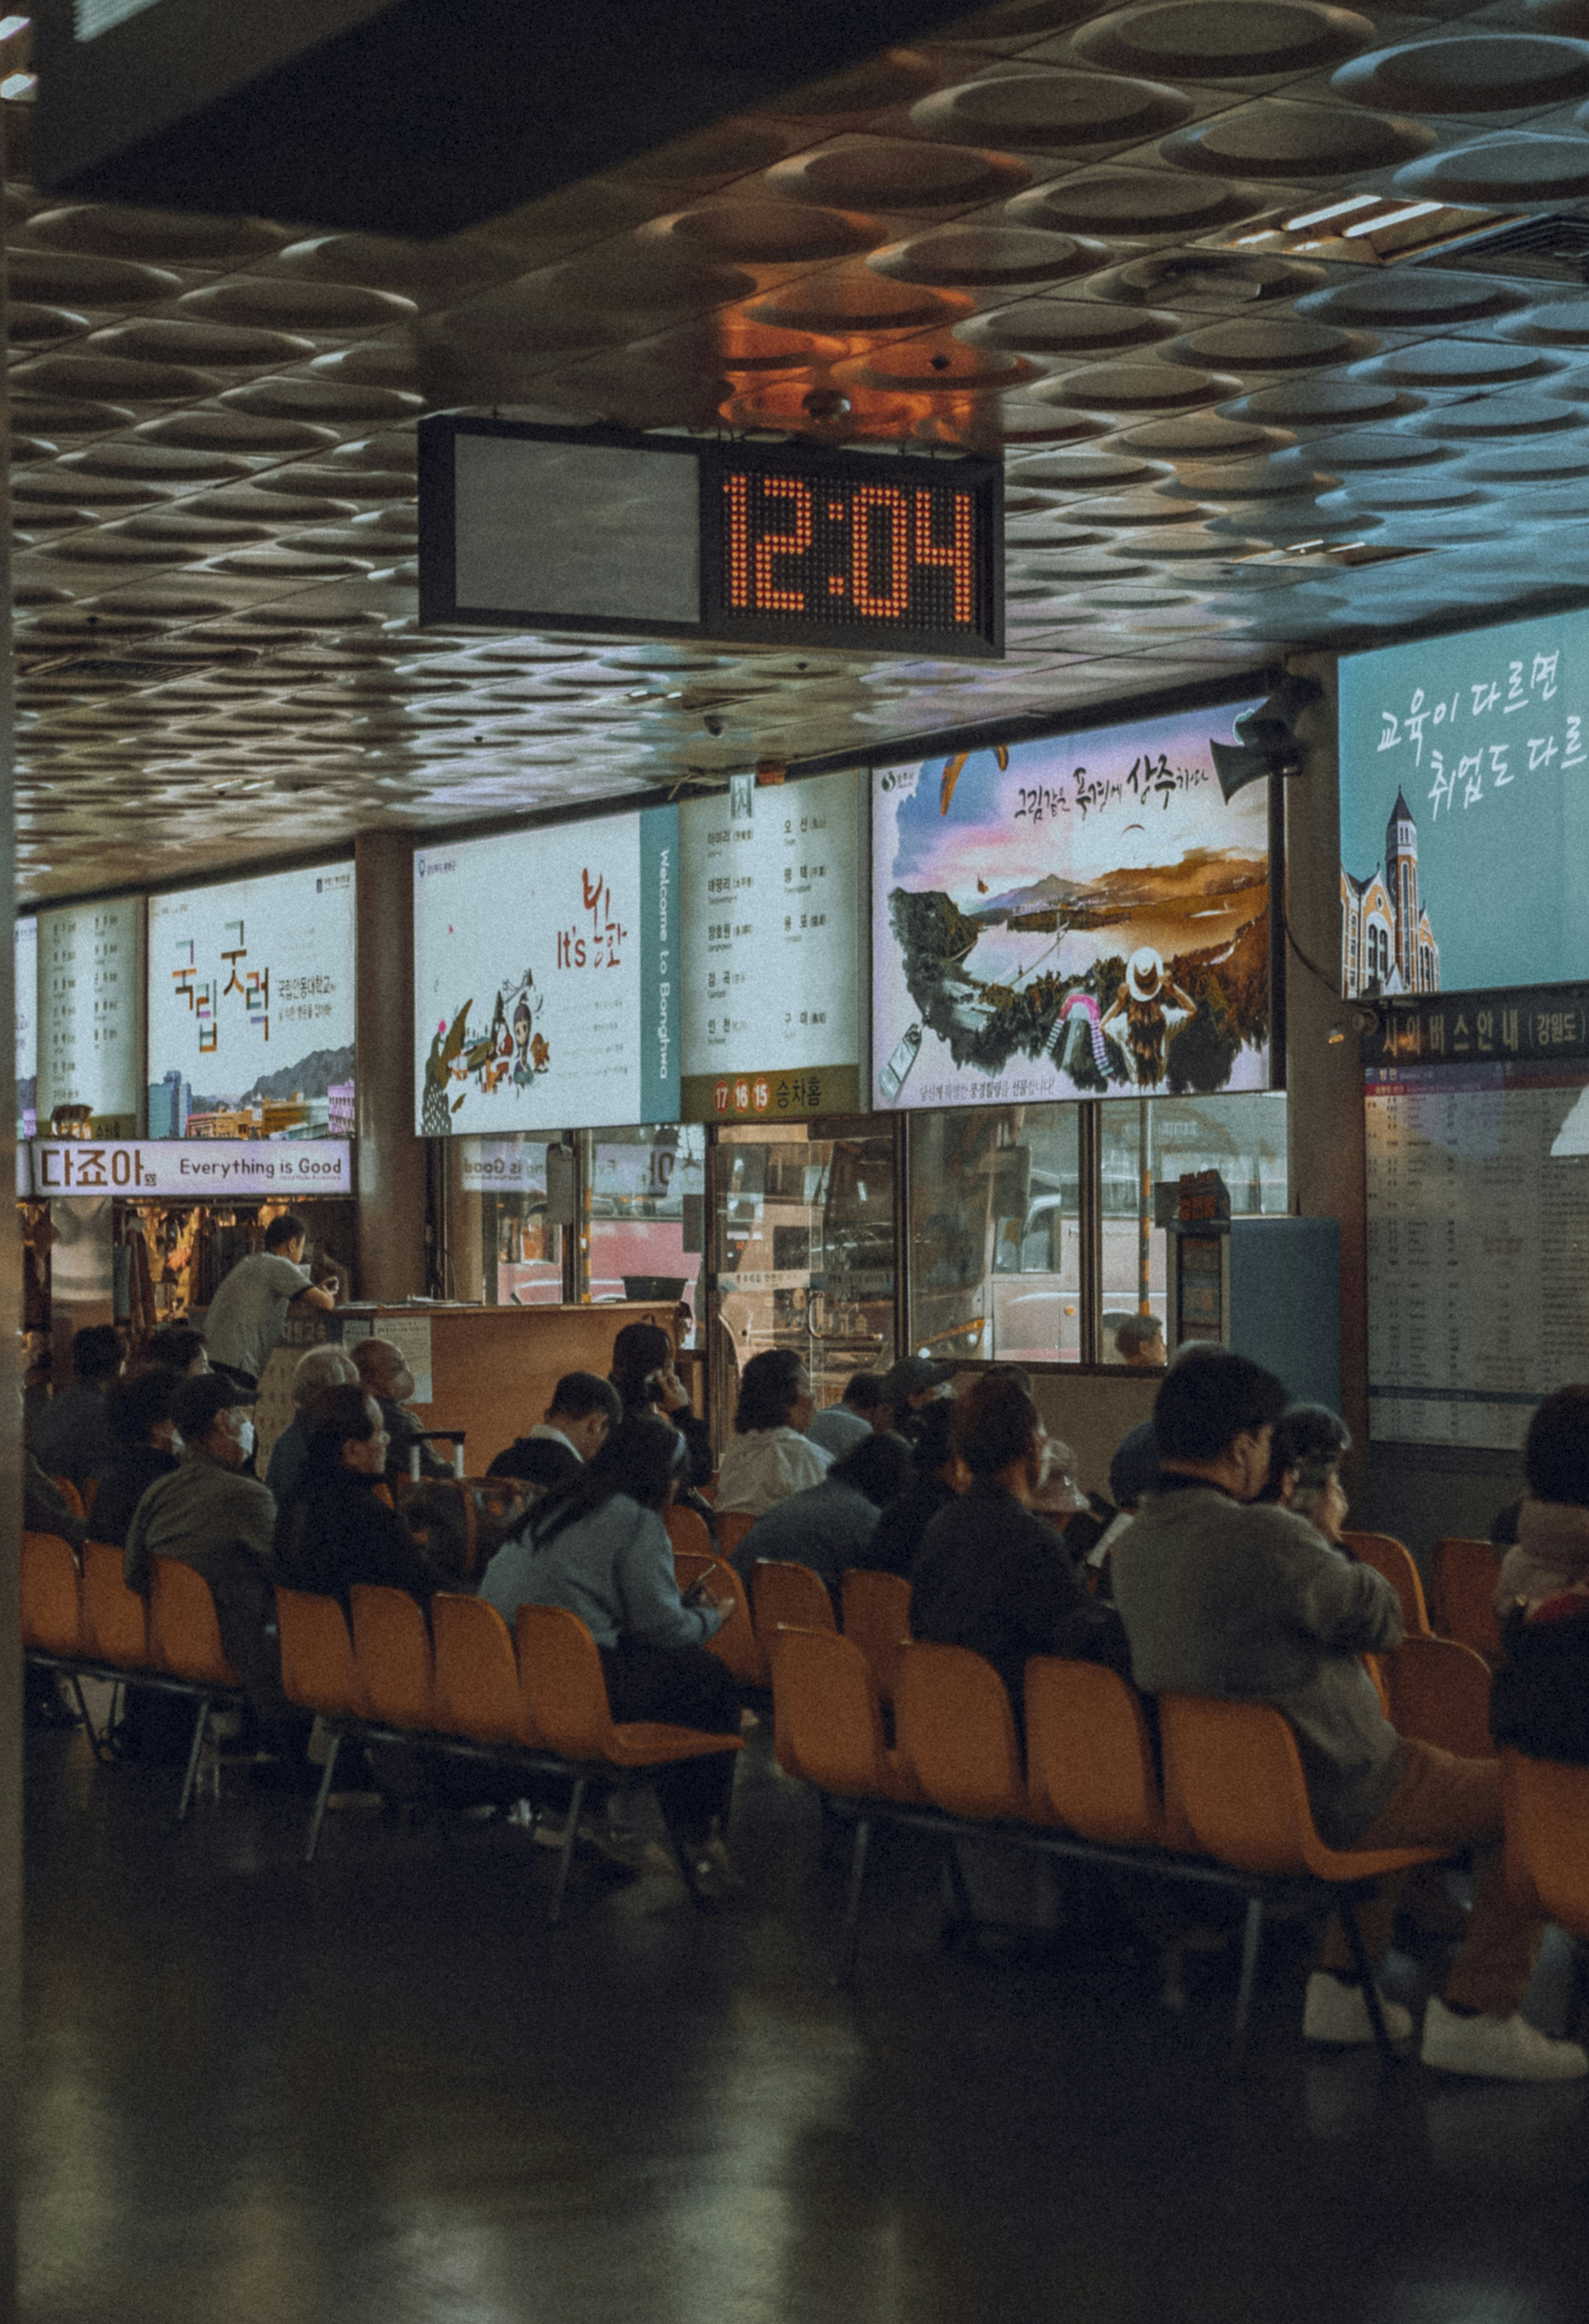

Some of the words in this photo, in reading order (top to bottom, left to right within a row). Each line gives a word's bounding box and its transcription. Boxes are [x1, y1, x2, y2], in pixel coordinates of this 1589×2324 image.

[723, 474, 971, 623] 12:04
[1377, 687, 1459, 767] 교육이
[1471, 650, 1560, 716] 다르면
[1429, 744, 1515, 822] 취업도
[557, 925, 587, 970] It's
[582, 867, 628, 969] 봉화
[658, 849, 670, 942] Welcome
[658, 950, 667, 976] to
[658, 982, 670, 1080] Bonghwa
[1382, 1008, 1519, 1058] 시외버스안내
[1528, 1008, 1586, 1048] (강원도)
[715, 1087, 728, 1109] 17
[735, 1084, 749, 1108] 16
[754, 1084, 768, 1107] 15
[776, 1076, 821, 1109] 승차홈
[41, 1149, 145, 1187] 다죠아
[180, 1158, 275, 1178] Everything
[279, 1158, 293, 1174] is
[299, 1157, 342, 1174] Good
